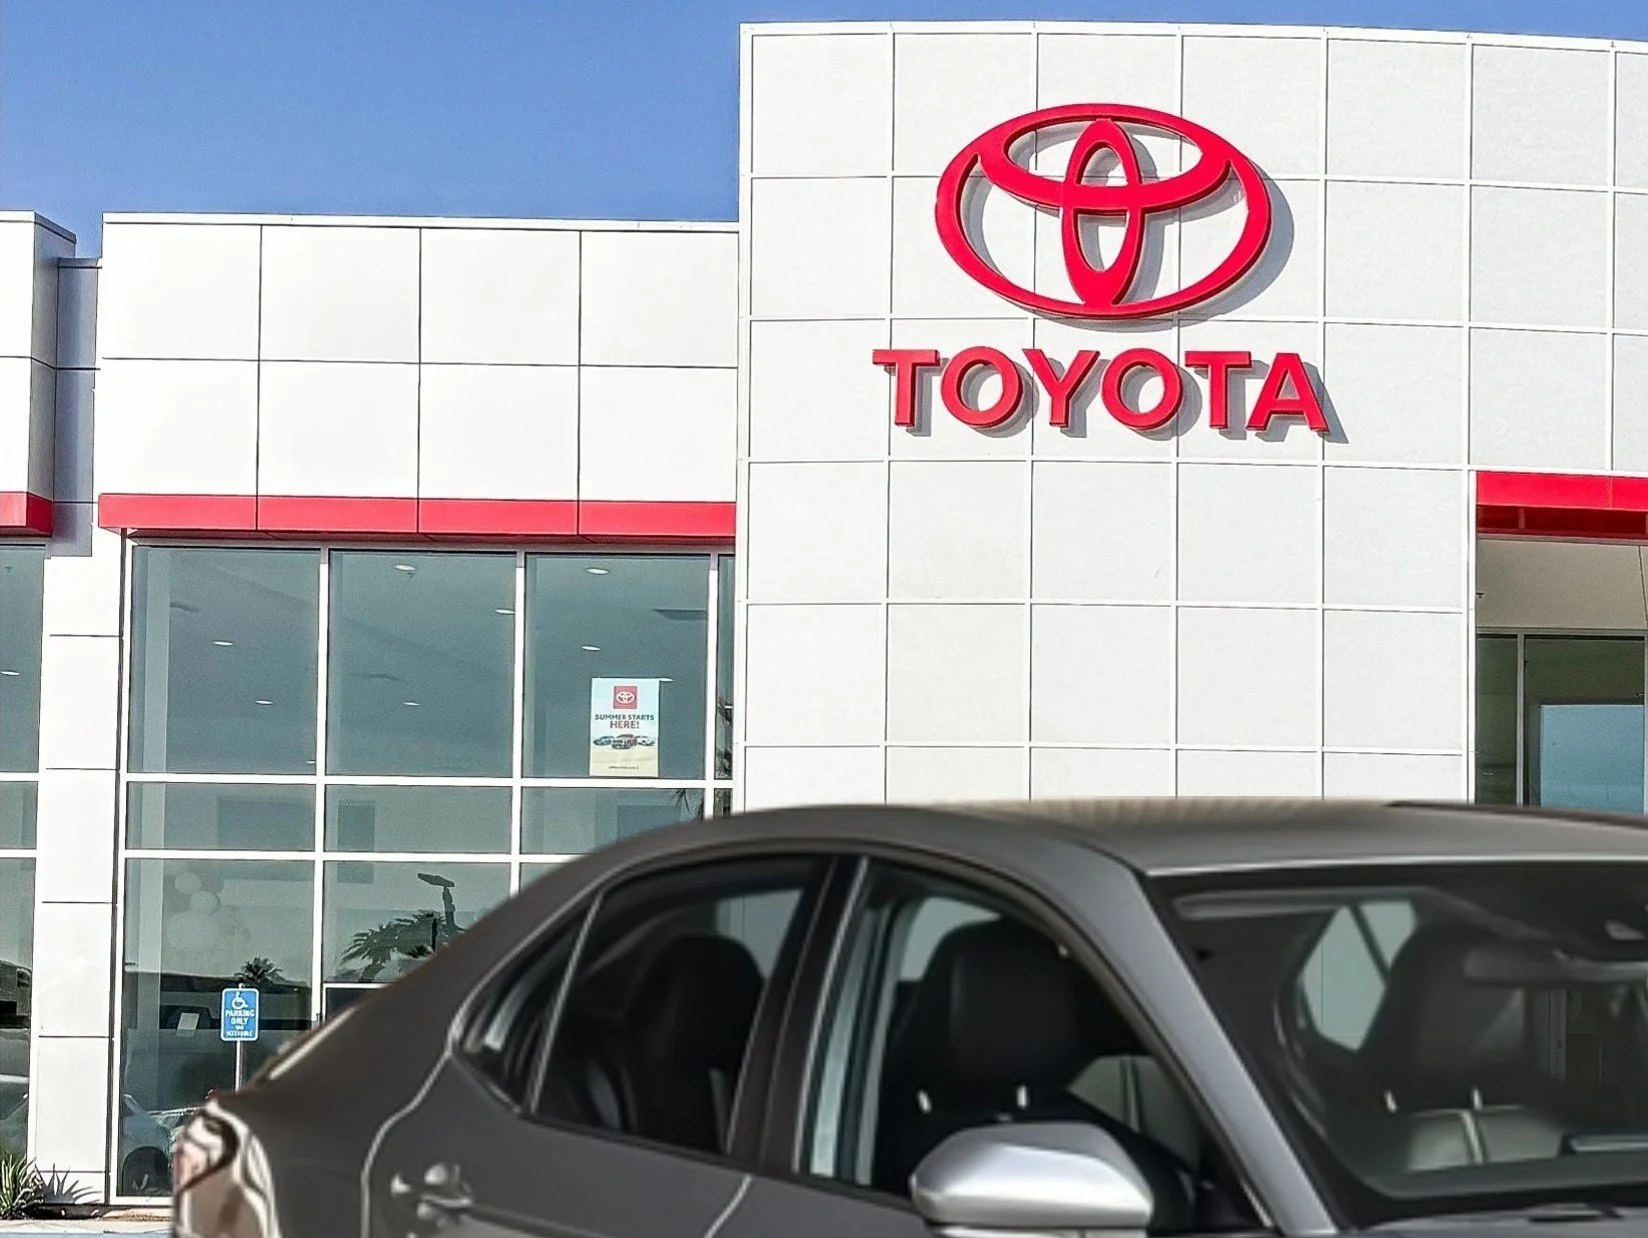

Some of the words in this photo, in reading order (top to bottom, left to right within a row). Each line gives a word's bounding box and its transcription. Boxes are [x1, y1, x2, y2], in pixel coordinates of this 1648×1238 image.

[872, 345, 1330, 433] TOYOTA
[609, 720, 640, 729] HERE!
[225, 1009, 255, 1017] PARKING
[230, 1017, 249, 1025] ONLY
